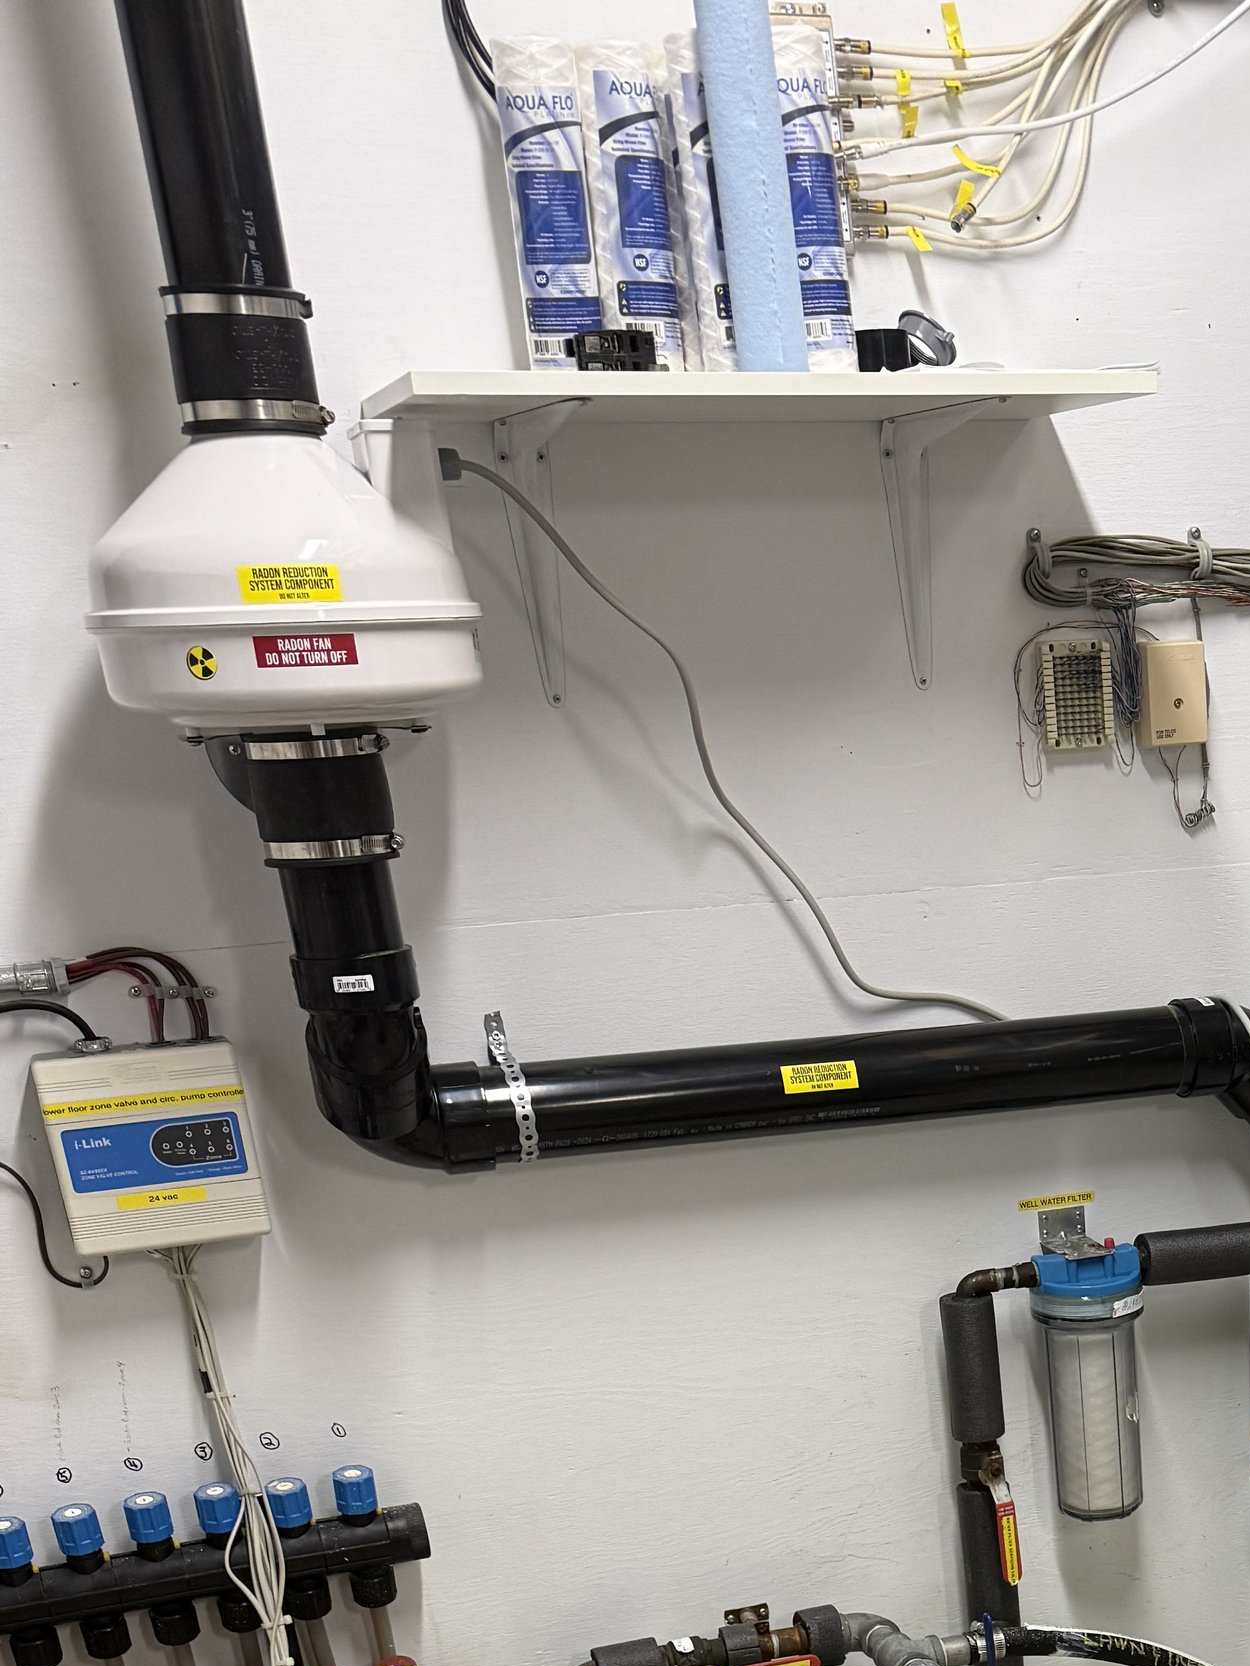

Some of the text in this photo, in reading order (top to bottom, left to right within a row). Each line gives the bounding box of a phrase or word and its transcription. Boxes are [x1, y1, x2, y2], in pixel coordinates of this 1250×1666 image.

[505, 95, 574, 113] AQUA FLO
[635, 258, 647, 267] NSF
[798, 257, 810, 266] NSF
[536, 273, 547, 283] NSF
[252, 567, 329, 579] RADON REDUCTION
[249, 578, 335, 591] SYSTEM COMPONENT
[277, 638, 332, 651] RADON FAN
[265, 651, 348, 665] DO NOT TURN OFF
[792, 1063, 847, 1075] RADON REDUCTION
[790, 1071, 851, 1084] SYSTEM COMPONENT
[68, 1105, 87, 1113] floor
[114, 1099, 138, 1107] valve
[181, 1093, 206, 1101] pump
[75, 1137, 111, 1150] i-Link
[1019, 1193, 1092, 1209] WELL WATER FILTER
